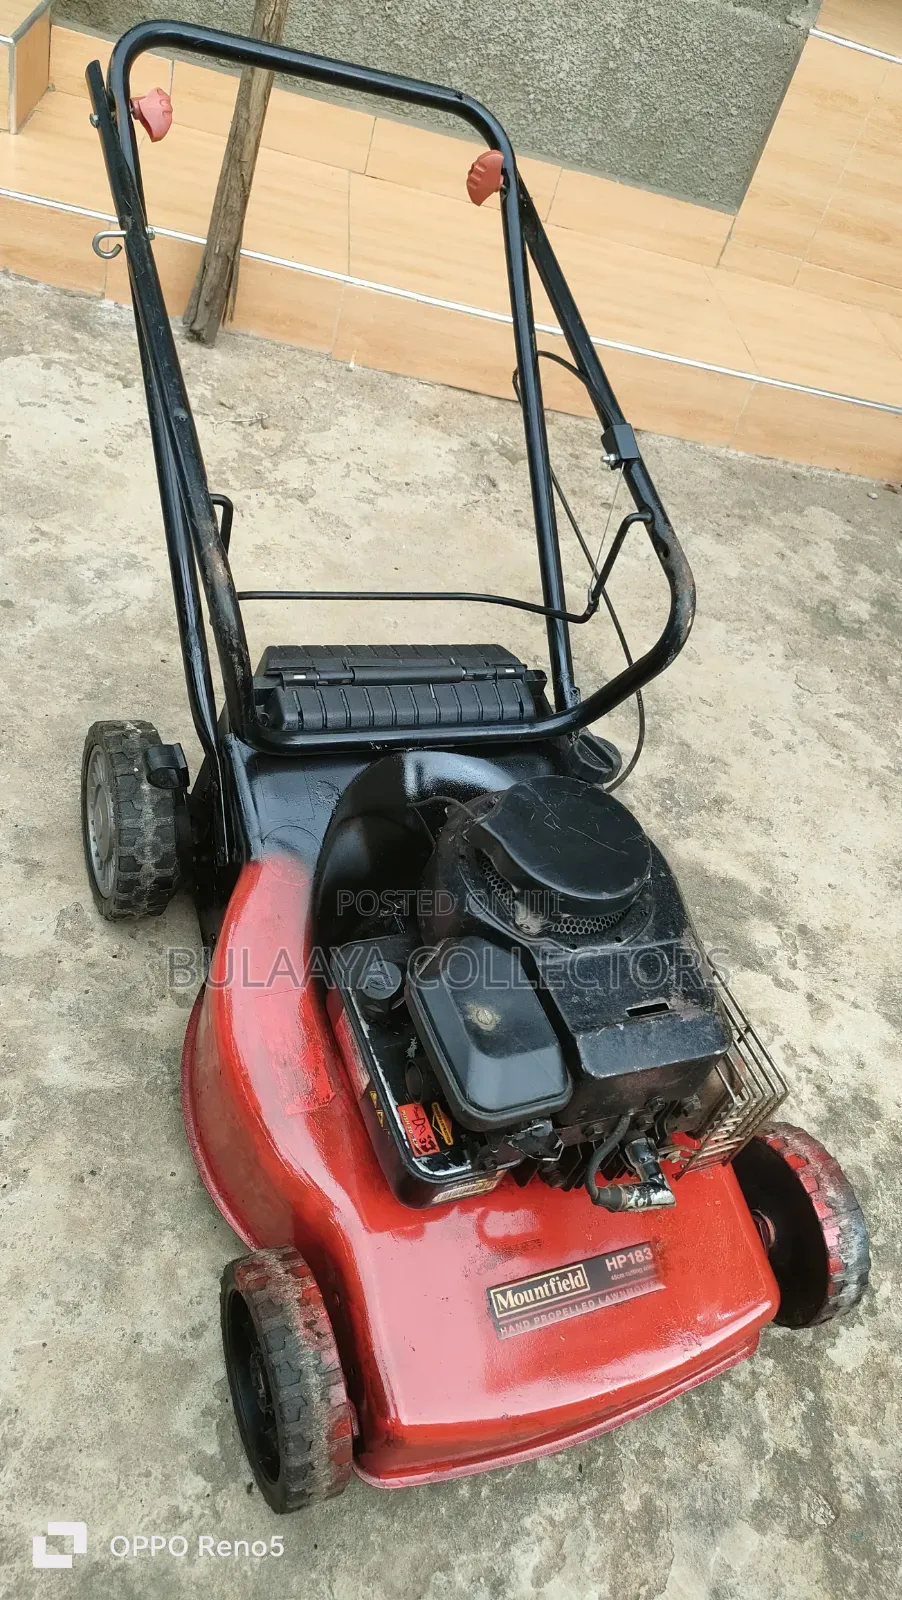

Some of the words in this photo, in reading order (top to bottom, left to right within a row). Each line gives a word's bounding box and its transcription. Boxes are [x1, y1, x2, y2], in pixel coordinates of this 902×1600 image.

[402, 1109, 411, 1126] PUSH
[407, 1125, 414, 1134] TO
[604, 1247, 654, 1272] HP183
[494, 1269, 586, 1312] Mountfield
[500, 1320, 531, 1337] HAND
[533, 1300, 595, 1325] PROPELLED
